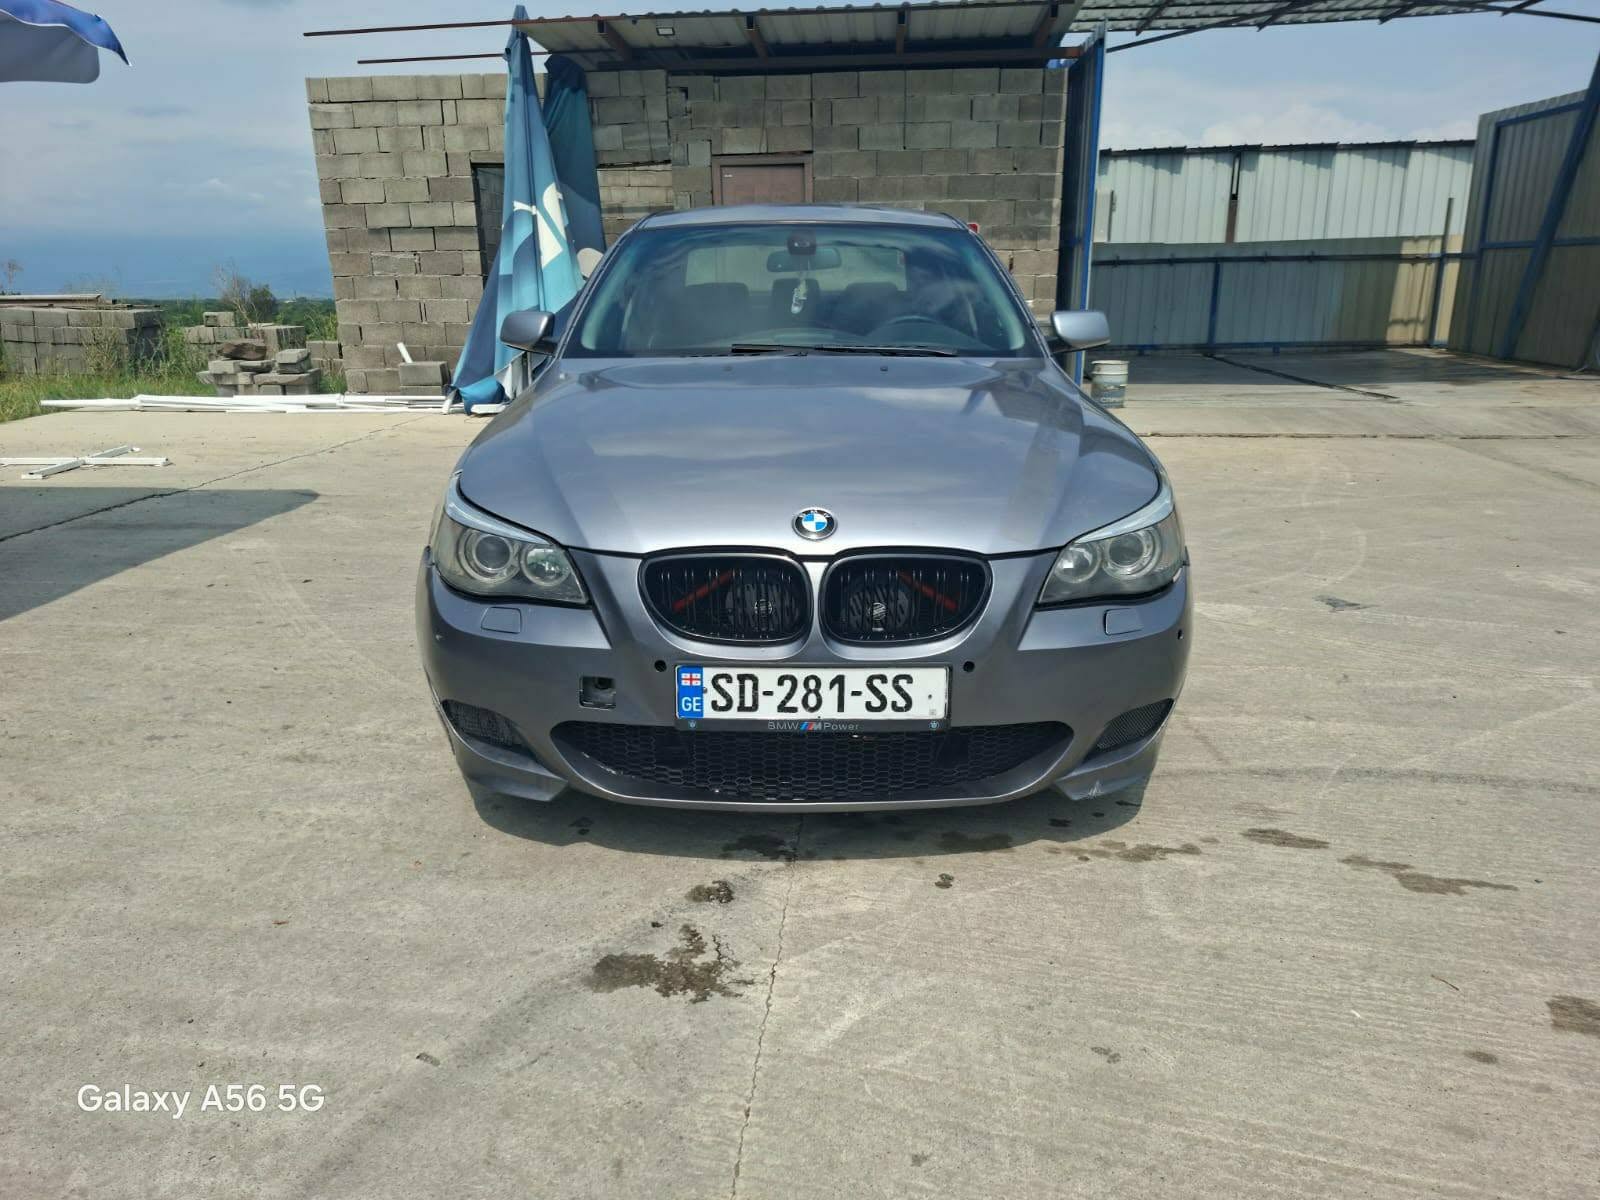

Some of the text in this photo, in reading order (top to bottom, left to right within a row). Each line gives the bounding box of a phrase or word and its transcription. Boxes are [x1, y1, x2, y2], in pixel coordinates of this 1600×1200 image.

[710, 673, 914, 714] SD-281-SS
[681, 696, 702, 712] GE
[767, 721, 799, 730] BMW
[823, 721, 859, 731] Power
